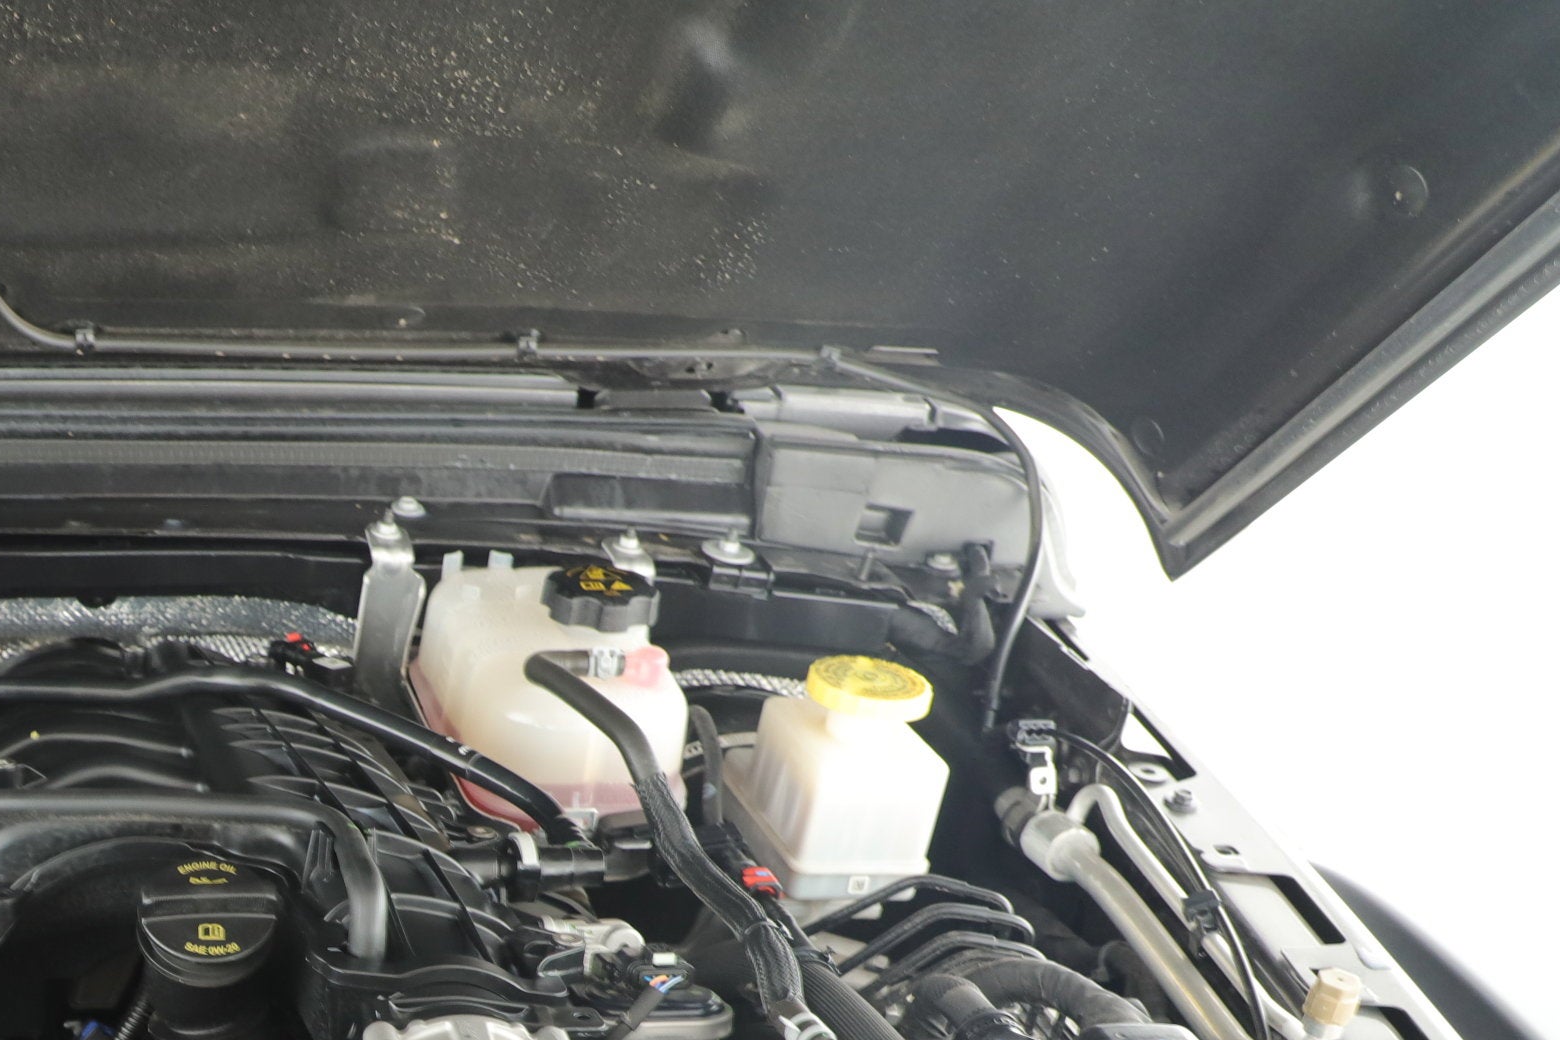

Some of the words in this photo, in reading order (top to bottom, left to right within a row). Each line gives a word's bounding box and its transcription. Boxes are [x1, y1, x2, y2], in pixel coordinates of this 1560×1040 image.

[177, 861, 219, 875] ENGINE
[219, 863, 237, 875] OIL
[184, 942, 208, 956] SAE
[208, 942, 241, 956] 0W-20
